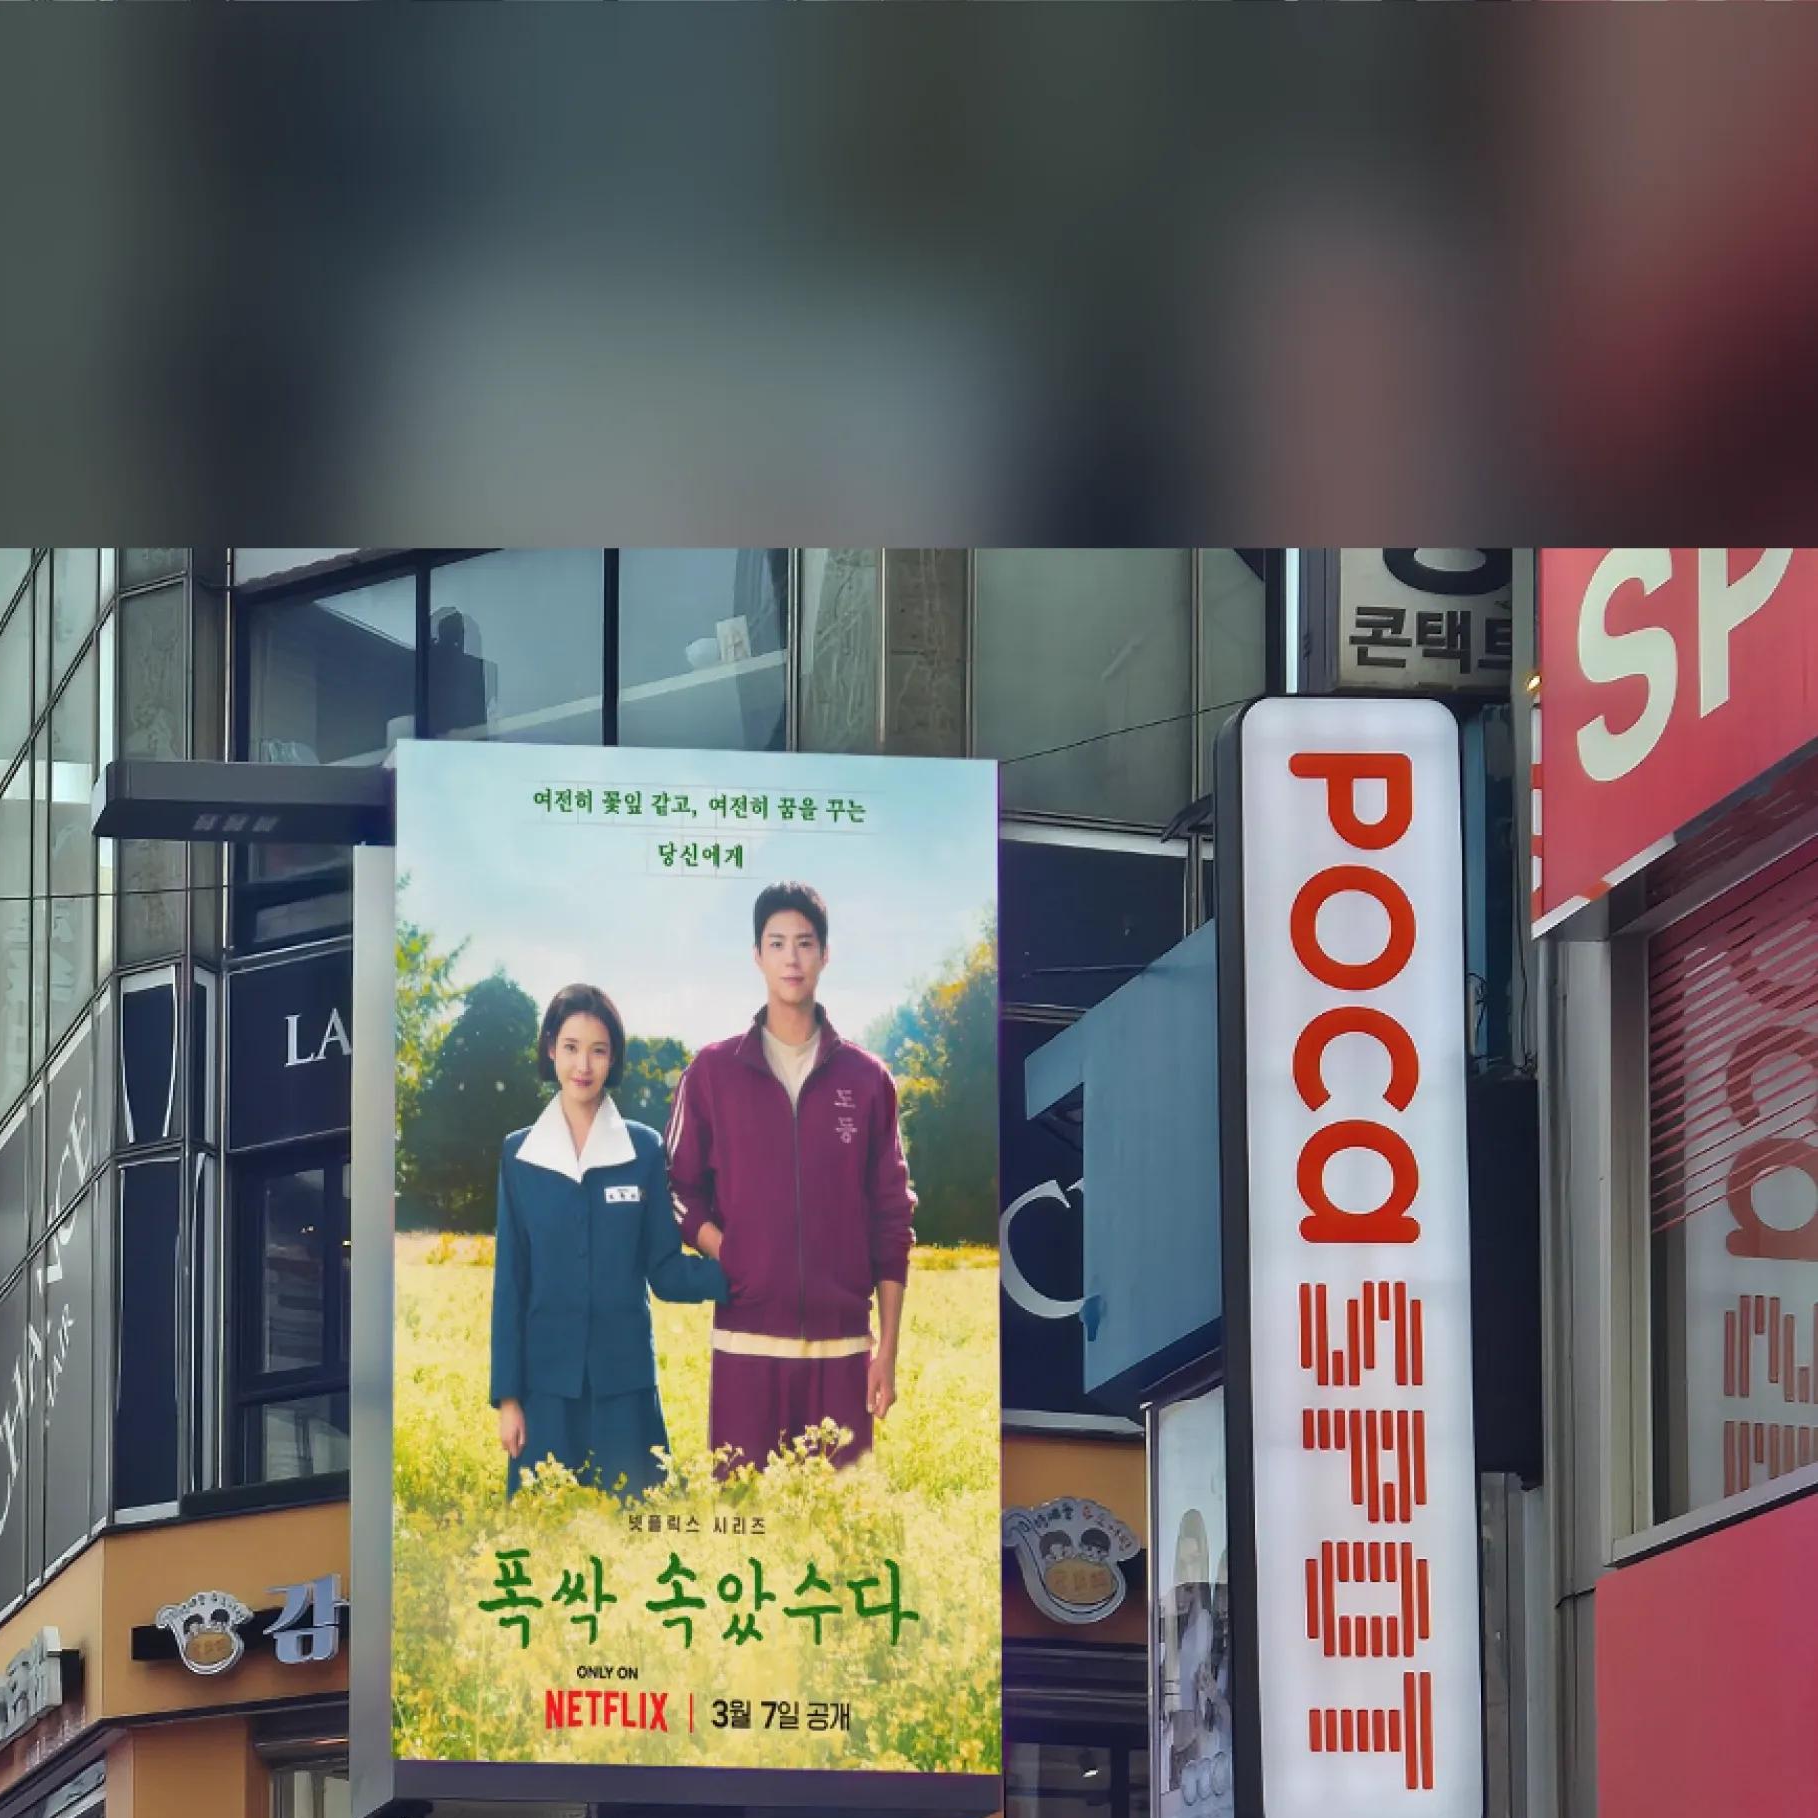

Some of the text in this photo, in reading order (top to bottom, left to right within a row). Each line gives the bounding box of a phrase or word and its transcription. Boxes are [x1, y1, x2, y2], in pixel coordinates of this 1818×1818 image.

[533, 789, 866, 823] 여전히 꽃잎 같고, 여전히 꿈을 꾸는
[658, 843, 744, 869] 당신에게
[628, 1514, 766, 1535] 넷플릭스 시리즈
[478, 1548, 920, 1649] 폭싹 속았수다
[577, 1665, 639, 1681] ONLY ON
[545, 1690, 668, 1732] NETFLIX
[711, 1700, 850, 1732] 3월 7일 공개
